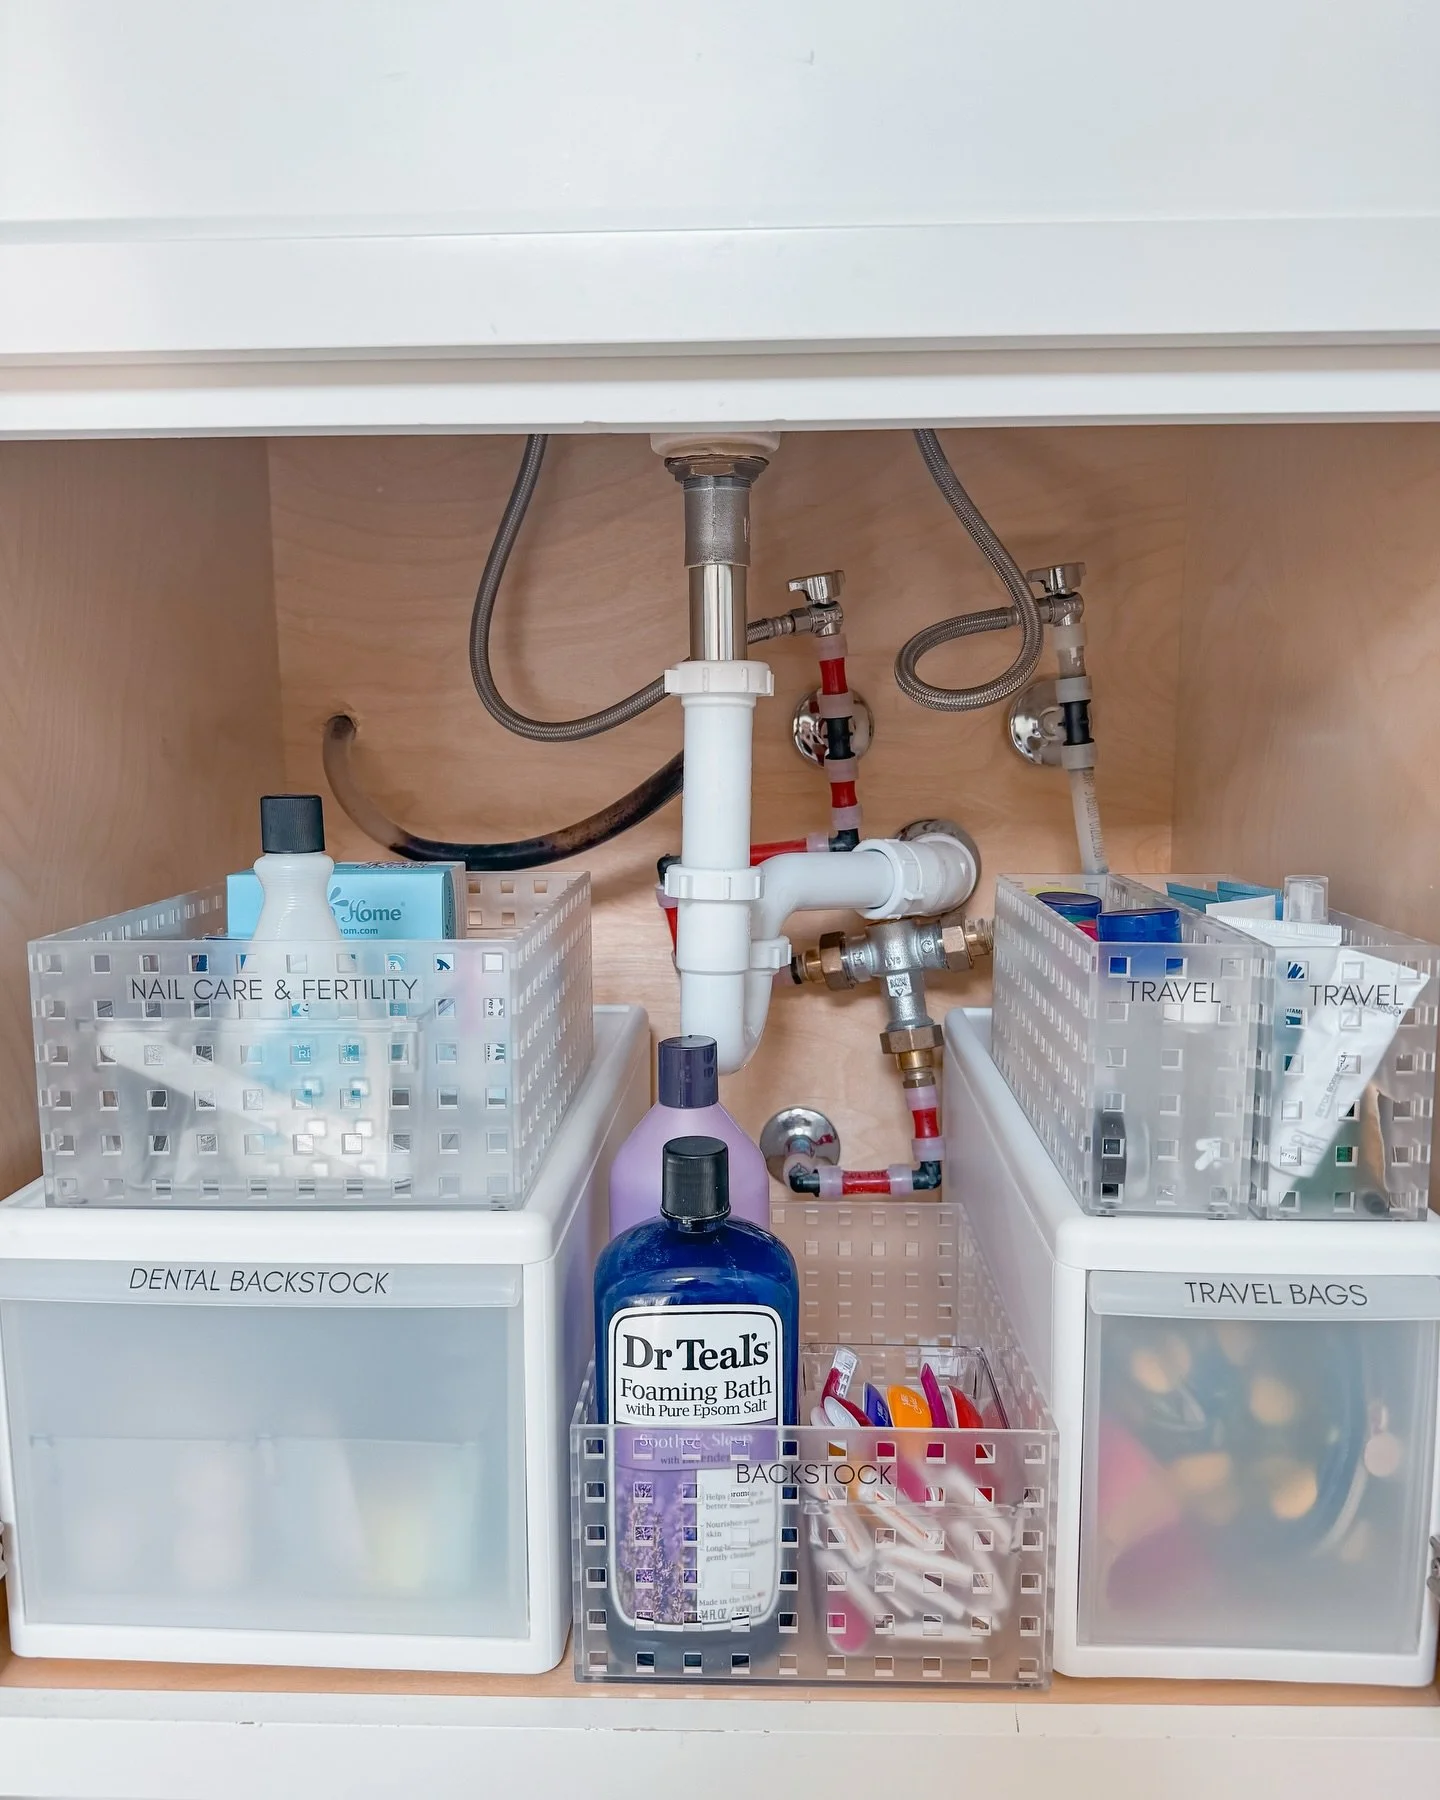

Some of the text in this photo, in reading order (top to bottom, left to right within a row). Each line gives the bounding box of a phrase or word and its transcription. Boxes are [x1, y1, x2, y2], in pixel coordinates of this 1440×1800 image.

[341, 900, 402, 922] Home
[131, 979, 418, 1000] NAIL CARE & FERTILITY
[1127, 981, 1221, 1003] TRAVEL
[1309, 984, 1404, 1006] TRAVEL
[129, 1268, 389, 1294] DENTAL BACKSTOCK
[1185, 1282, 1368, 1306] TRAVEL BAGS
[623, 1332, 769, 1370] Dr Teal's
[621, 1376, 772, 1404] Foaming Bath
[626, 1399, 768, 1418] with Pure Epsom Salt
[736, 1463, 893, 1486] BACKSTOCK
